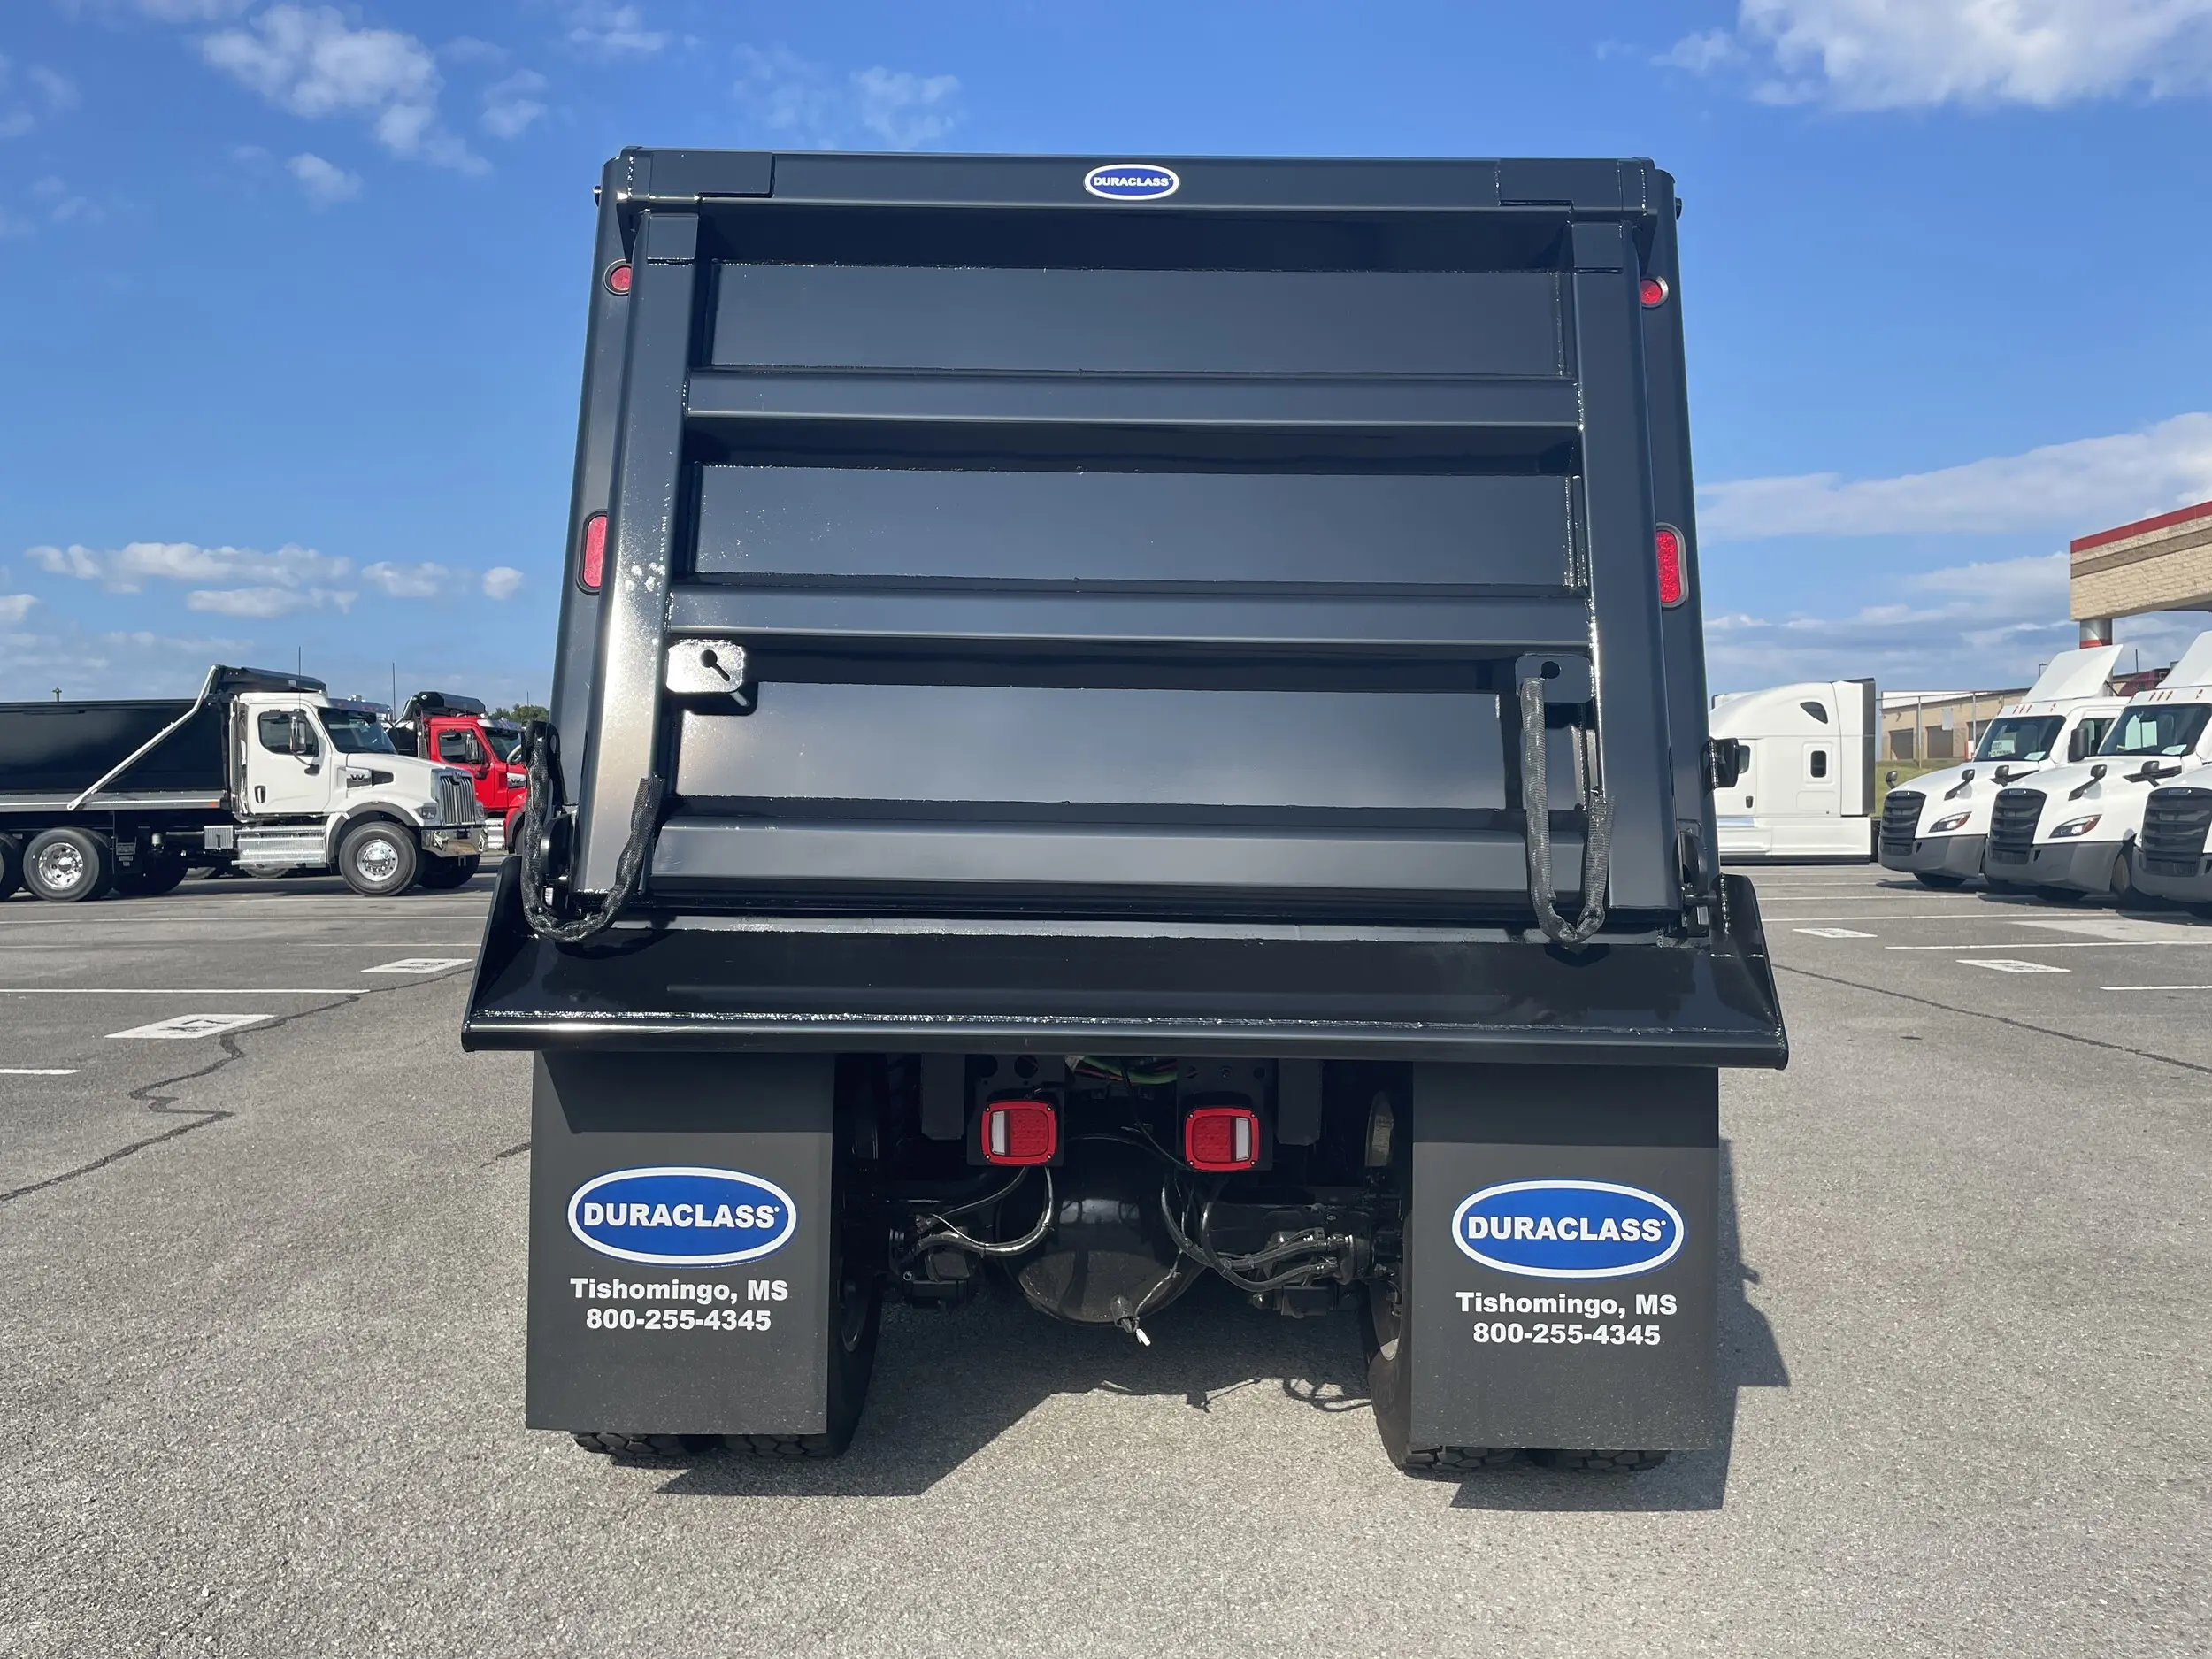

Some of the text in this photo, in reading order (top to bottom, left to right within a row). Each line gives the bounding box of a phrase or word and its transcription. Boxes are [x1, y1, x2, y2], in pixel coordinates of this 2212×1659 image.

[1093, 176, 1170, 187] DURACLASS
[583, 1202, 775, 1229] DURACLASS
[1467, 1216, 1662, 1242] DURACLASS
[570, 1277, 788, 1305] Tishomingo, MS
[1455, 1291, 1678, 1320] Tishomingo, MS
[586, 1308, 772, 1332] 800-255-4345
[1473, 1322, 1661, 1346] 800-255-4345
